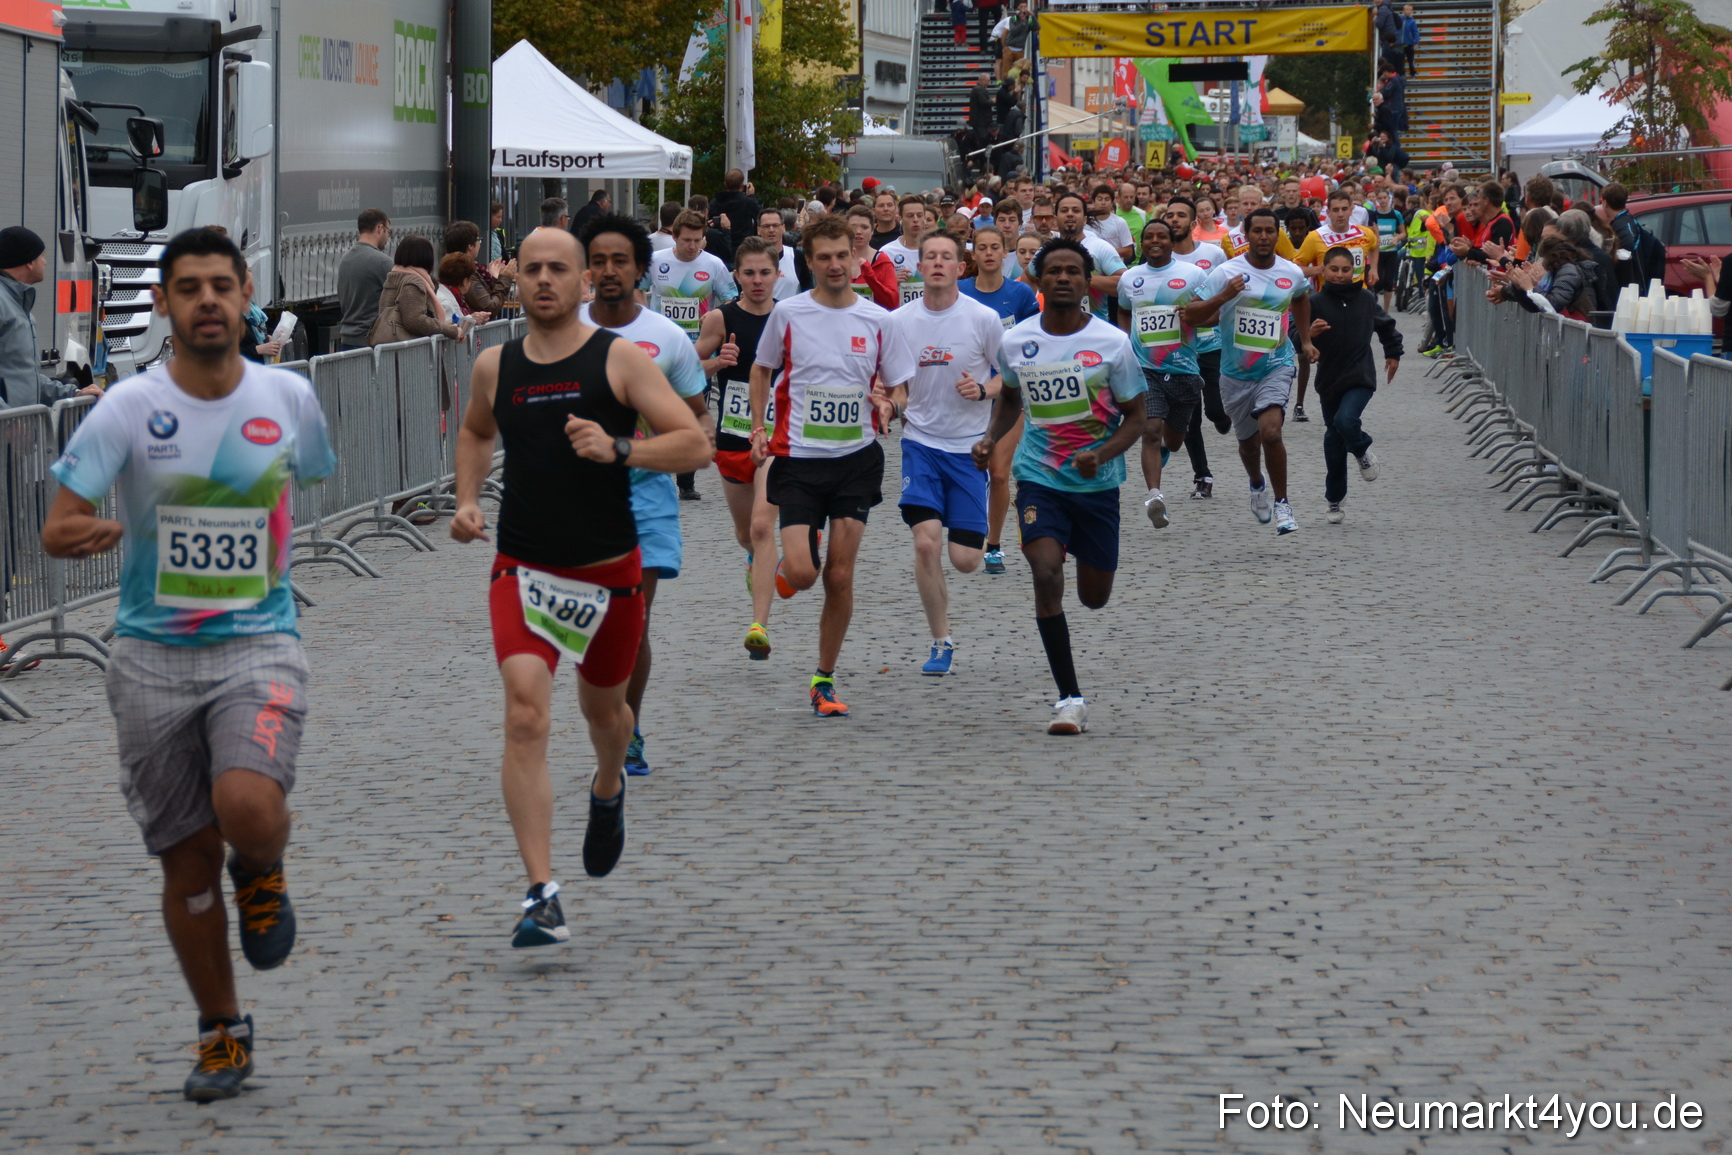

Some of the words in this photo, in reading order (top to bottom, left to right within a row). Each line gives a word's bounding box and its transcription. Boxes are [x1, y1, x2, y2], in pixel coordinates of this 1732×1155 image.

[1145, 20, 1257, 47] START
[299, 34, 321, 80] OFFICE
[323, 37, 354, 84] INDUSTRY
[355, 42, 379, 87] LOUNGE
[394, 31, 437, 113] BOCK
[1150, 149, 1161, 163] A
[1341, 142, 1349, 154] C
[502, 149, 605, 172] Laufsport
[664, 305, 696, 320] 5070
[1236, 310, 1251, 318] PARTL
[1252, 312, 1274, 320] Neumarkt
[1140, 314, 1176, 333] 5327
[1238, 318, 1275, 338] 5331
[919, 347, 952, 362] SGT
[1020, 371, 1038, 379] PARTL
[1039, 367, 1071, 378] Neumarkt
[527, 382, 582, 396] CHOOZA
[728, 385, 747, 395] PARTL
[806, 390, 827, 399] PARTL
[828, 392, 856, 400] Neumarkt
[1026, 375, 1081, 402] 5329
[729, 394, 775, 422] 516
[810, 400, 860, 424] 5309
[148, 444, 181, 454] PARTL
[160, 515, 195, 528] PARTL
[198, 517, 251, 529] Neumarkt
[169, 531, 258, 572] 5333
[549, 583, 593, 600] Neumarkt
[528, 583, 597, 629] 5180
